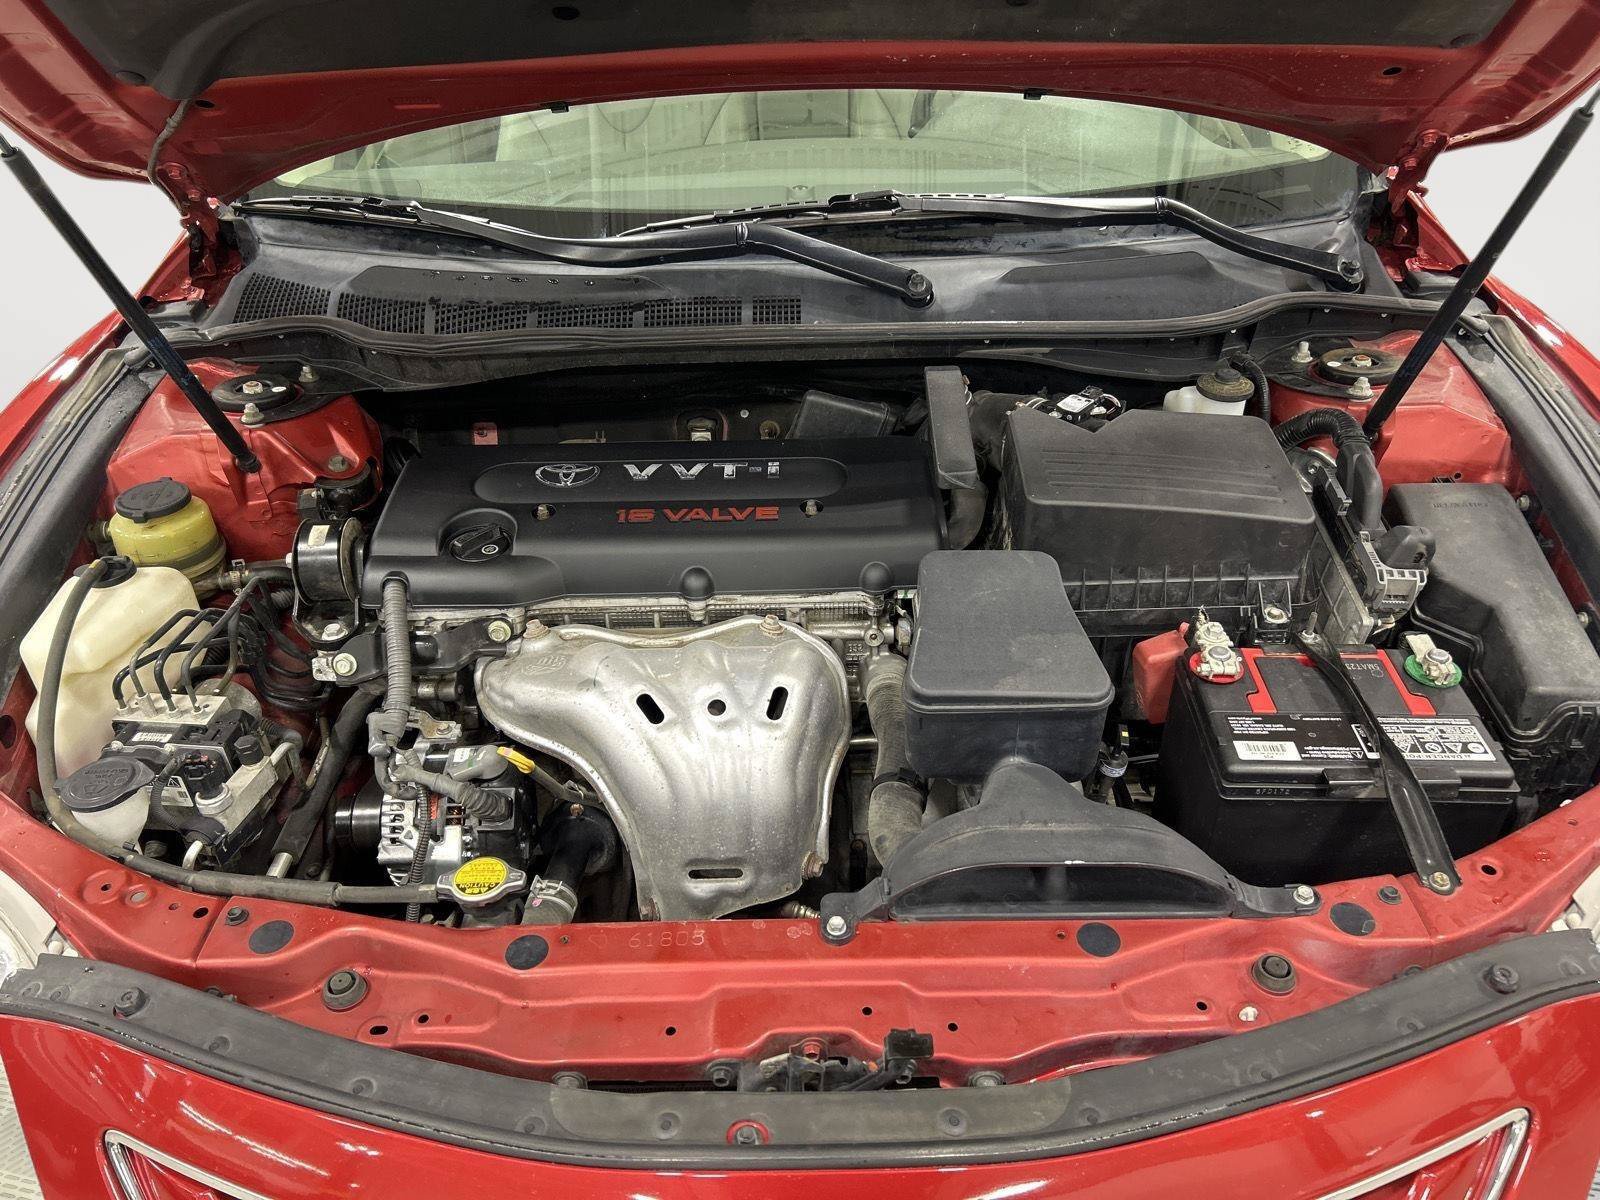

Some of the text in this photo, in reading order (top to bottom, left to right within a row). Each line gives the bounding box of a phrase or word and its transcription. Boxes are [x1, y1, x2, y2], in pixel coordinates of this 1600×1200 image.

[623, 461, 780, 481] VVT-i
[616, 506, 780, 523] 16 VALVE
